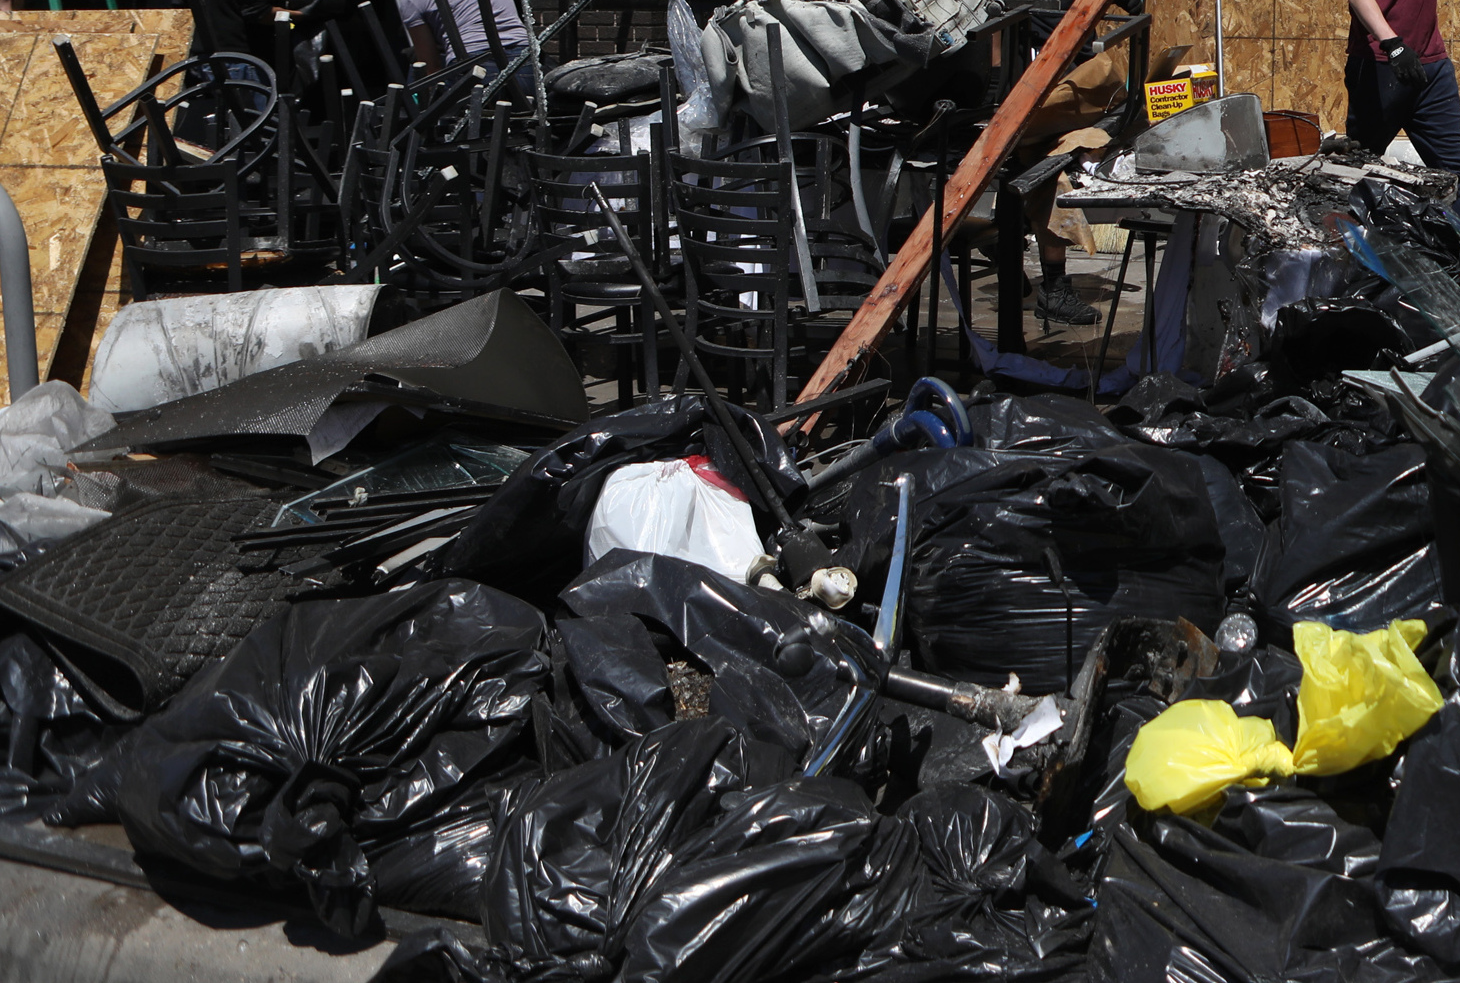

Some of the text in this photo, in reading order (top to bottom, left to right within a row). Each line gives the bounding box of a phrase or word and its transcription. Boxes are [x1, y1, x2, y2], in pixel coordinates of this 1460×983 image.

[1149, 82, 1187, 96] HUSKY
[1150, 94, 1188, 104] Contractor
[1151, 102, 1183, 111] Clean-Up
[1152, 111, 1171, 119] Bags
